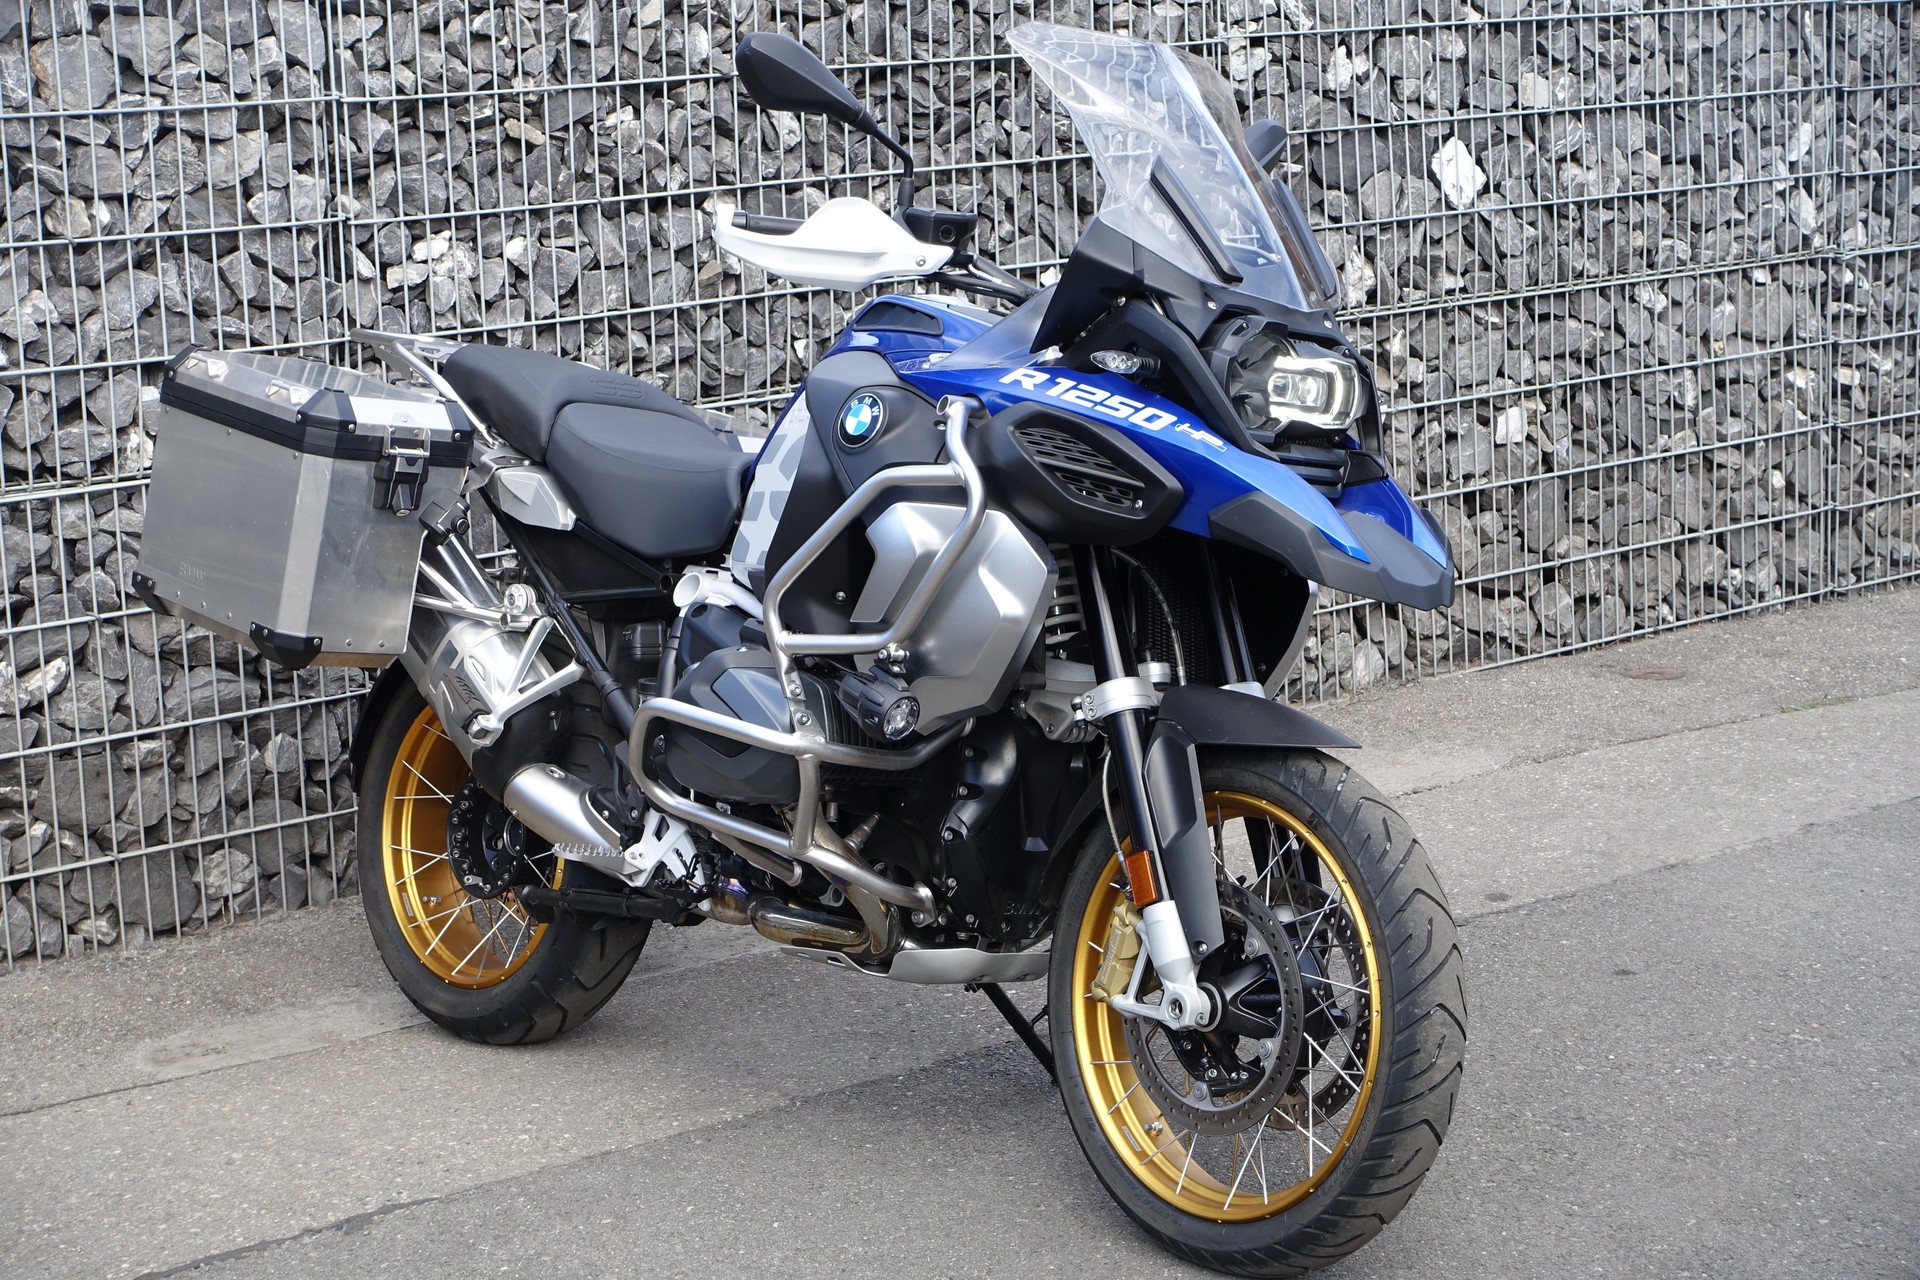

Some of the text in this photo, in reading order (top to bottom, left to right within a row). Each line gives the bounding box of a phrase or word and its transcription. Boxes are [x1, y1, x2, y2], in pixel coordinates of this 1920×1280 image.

[850, 396, 880, 416] BMW
[999, 368, 1050, 391] R
[1045, 378, 1178, 431] 1250
